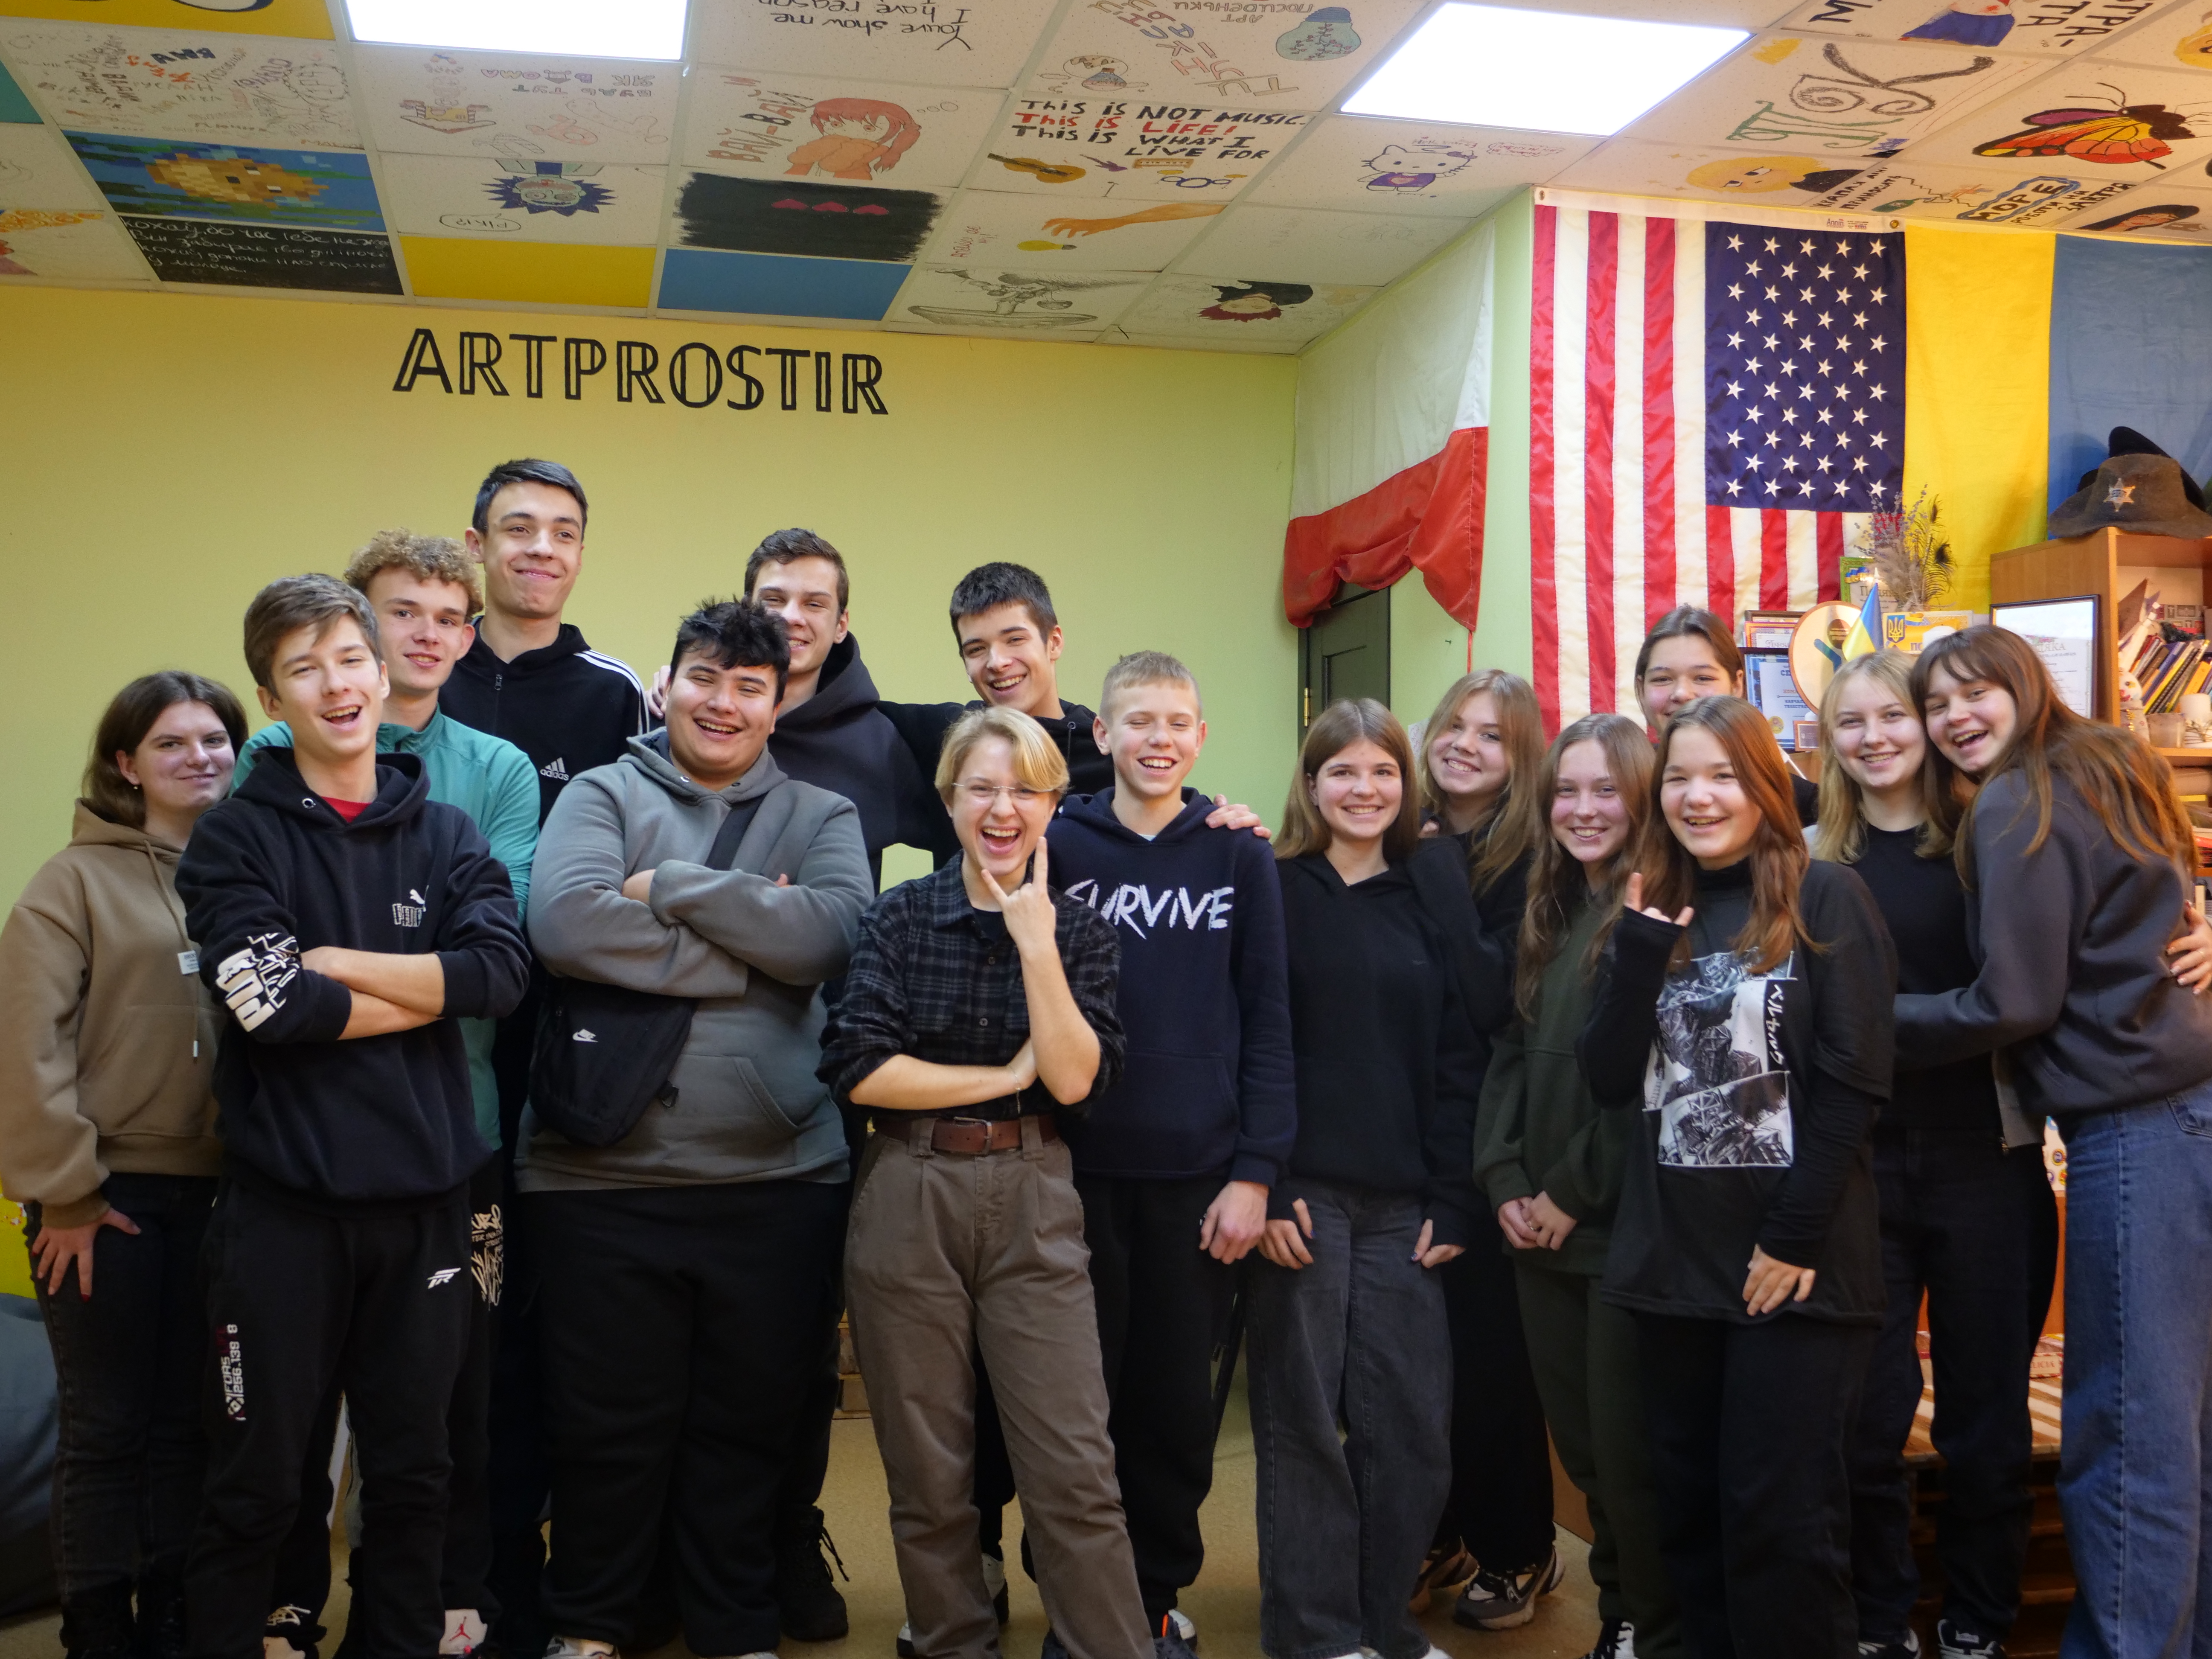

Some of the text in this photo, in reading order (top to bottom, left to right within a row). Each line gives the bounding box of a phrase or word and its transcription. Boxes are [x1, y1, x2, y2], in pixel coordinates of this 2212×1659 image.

[876, 4, 935, 23] have
[950, 9, 972, 24] I
[770, 12, 889, 37] show me
[1015, 112, 1080, 127] This
[1020, 100, 1087, 115] This
[1137, 105, 1213, 120] NOT
[1011, 125, 1078, 141] This
[1139, 134, 1224, 146] WHAT
[1223, 136, 1256, 148] I
[1217, 149, 1271, 160] FOR
[1969, 183, 2068, 220] МОРЕ
[392, 329, 889, 415] ARTPROSTIR
[540, 768, 569, 781] adidas
